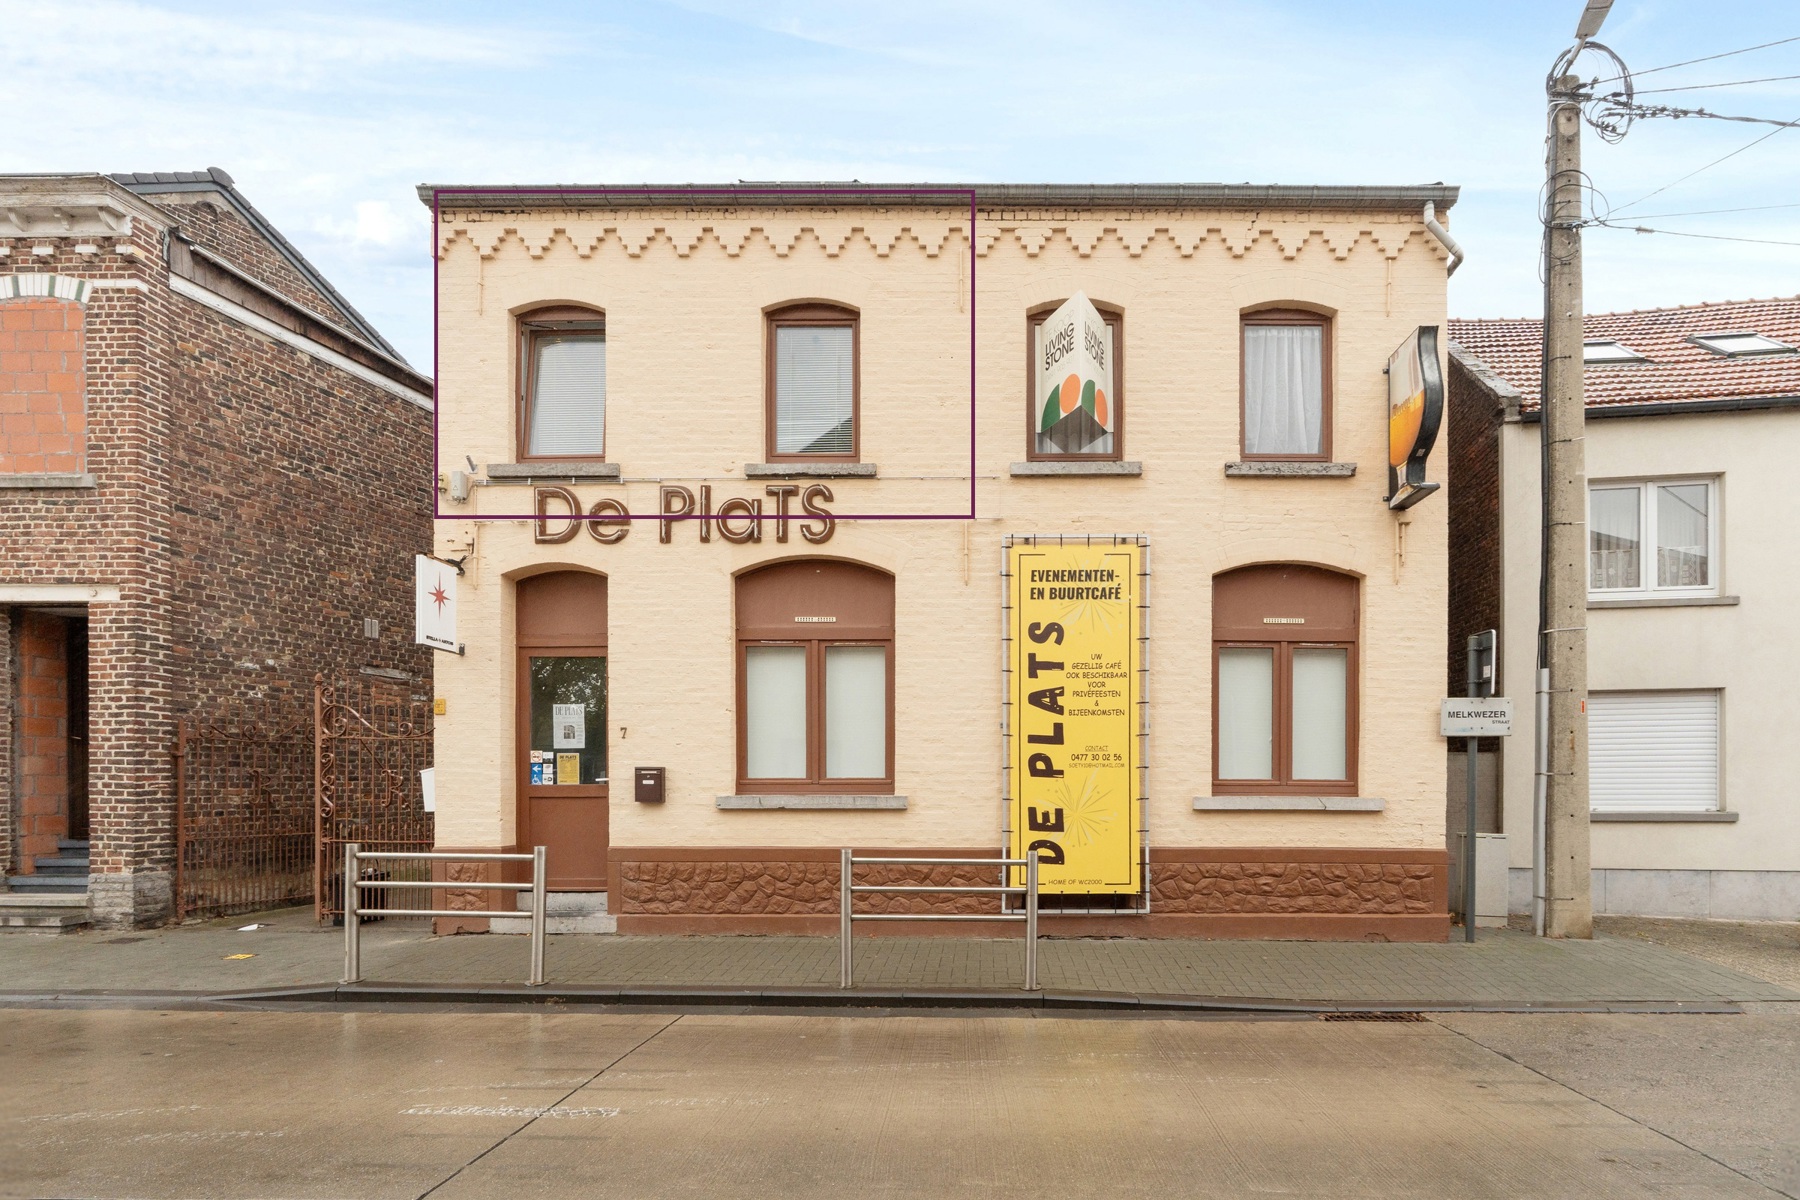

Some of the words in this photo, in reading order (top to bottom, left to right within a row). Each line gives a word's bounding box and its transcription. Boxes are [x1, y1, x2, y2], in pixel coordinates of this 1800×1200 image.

[1045, 322, 1075, 357] LIVING
[1084, 320, 1105, 356] LIVING
[1045, 335, 1075, 371] STONE
[1084, 335, 1105, 371] STONE
[534, 485, 631, 545] De
[1030, 569, 1120, 583] EVENEMENTEN-
[1030, 587, 1045, 600] EN
[1050, 583, 1122, 600] BUURTCAFÉ
[1071, 662, 1104, 670] GEZELLIG
[1105, 660, 1122, 670] CAFÉ
[1028, 621, 1065, 779] PLATS
[1072, 687, 1121, 698] PRIVÉFEESTEN
[1094, 699, 1100, 707] &
[1068, 709, 1126, 717] BIJEENKOMSTEN
[620, 727, 628, 739] 7
[1070, 753, 1089, 762] 0477
[1091, 753, 1100, 762] 30
[1101, 753, 1112, 762] 02
[1113, 753, 1123, 762] 56
[1028, 806, 1065, 865] DE
